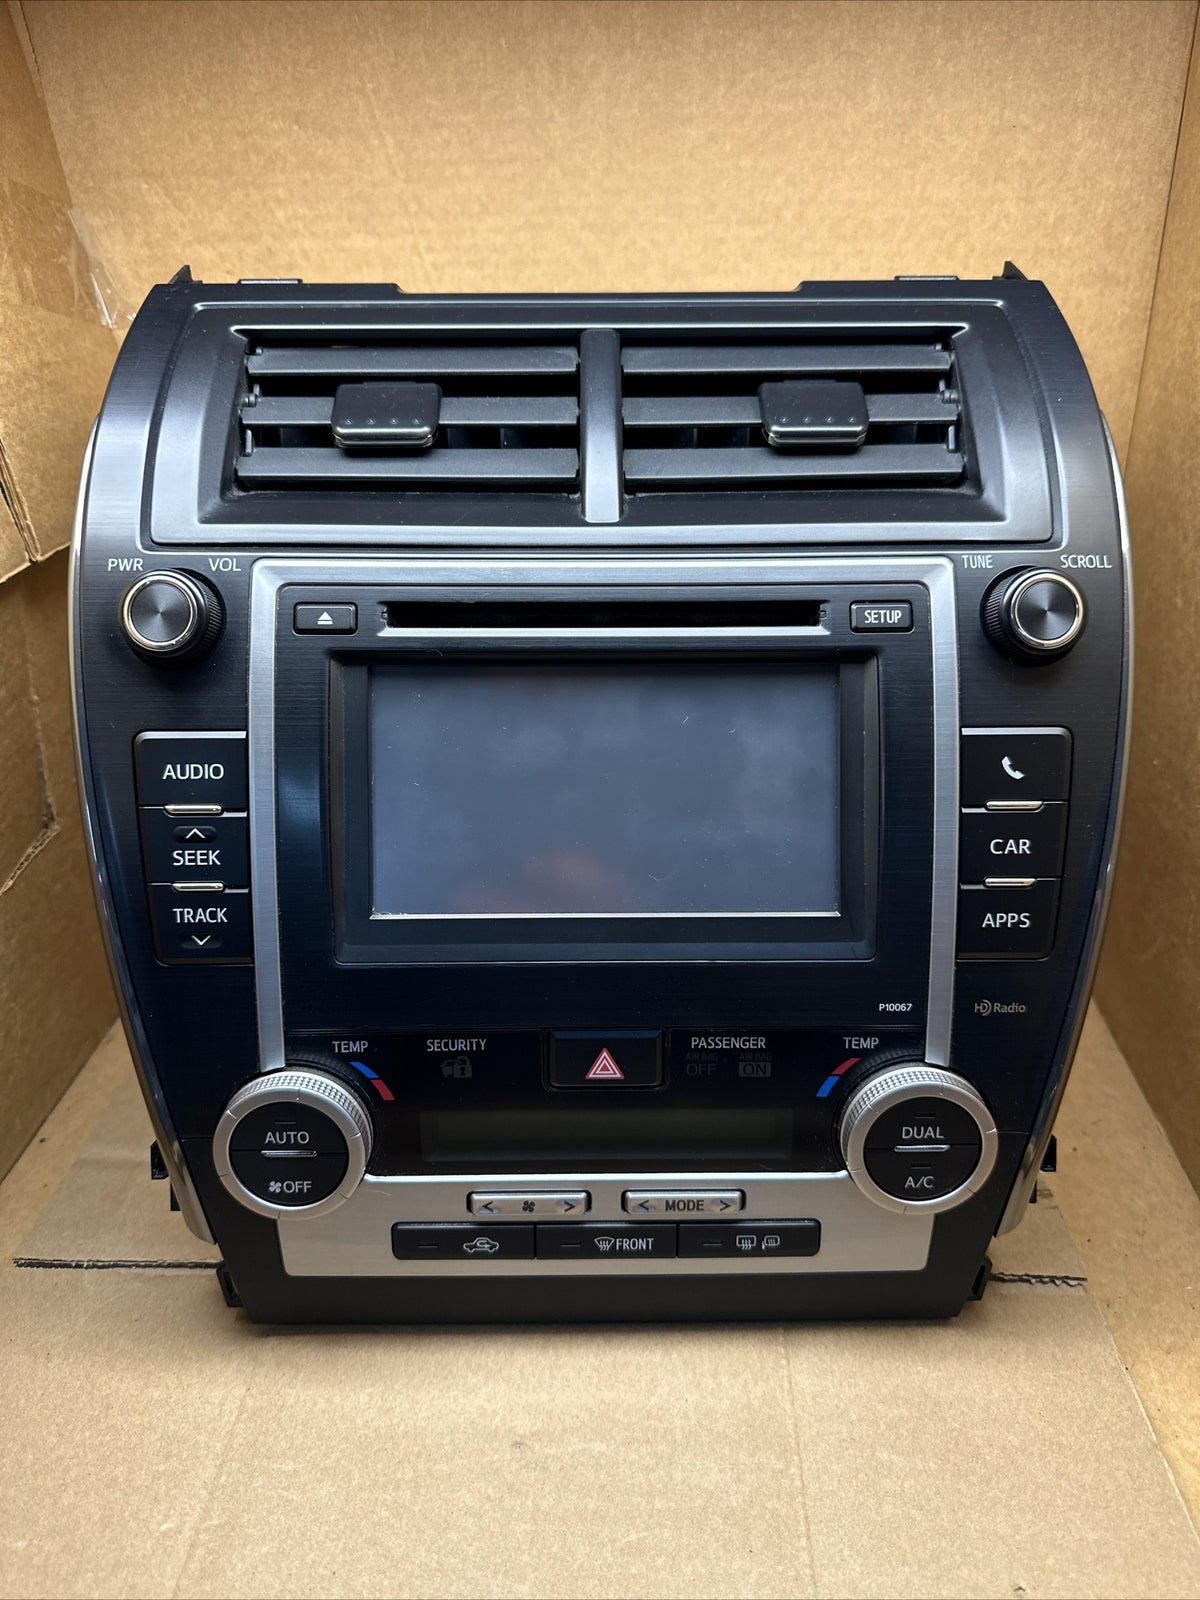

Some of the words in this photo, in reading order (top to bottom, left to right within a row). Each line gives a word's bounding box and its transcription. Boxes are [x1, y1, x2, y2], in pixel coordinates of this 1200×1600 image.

[107, 558, 144, 573] PWR
[208, 558, 242, 573] VOL
[961, 554, 994, 569] TUNE
[1060, 554, 1113, 569] SCROLL
[863, 609, 902, 625] SETUP
[162, 763, 225, 781] AUDIO
[989, 838, 1032, 856] CAR
[172, 850, 222, 866] SEEK
[172, 908, 228, 924] TRACK
[982, 912, 1031, 928] APPS
[878, 1002, 913, 1013] P10067
[994, 1001, 1026, 1015] Radio
[332, 1040, 369, 1054] TEMP
[426, 1038, 487, 1052] SECURITY
[690, 1036, 767, 1050] PASSENGER
[843, 1036, 879, 1050] TEMP
[685, 1053, 700, 1062] AIR
[701, 1053, 718, 1062] BAG
[739, 1052, 753, 1061] AIR
[754, 1052, 772, 1061] BAG
[686, 1063, 717, 1077] OFF
[742, 1063, 767, 1077] ON
[265, 1131, 310, 1145] AUTO
[901, 1126, 944, 1140] DUAL
[283, 1180, 312, 1194] OFF
[905, 1175, 934, 1189] A/C
[665, 1199, 705, 1212] MODE
[616, 1237, 654, 1251] FRONT
